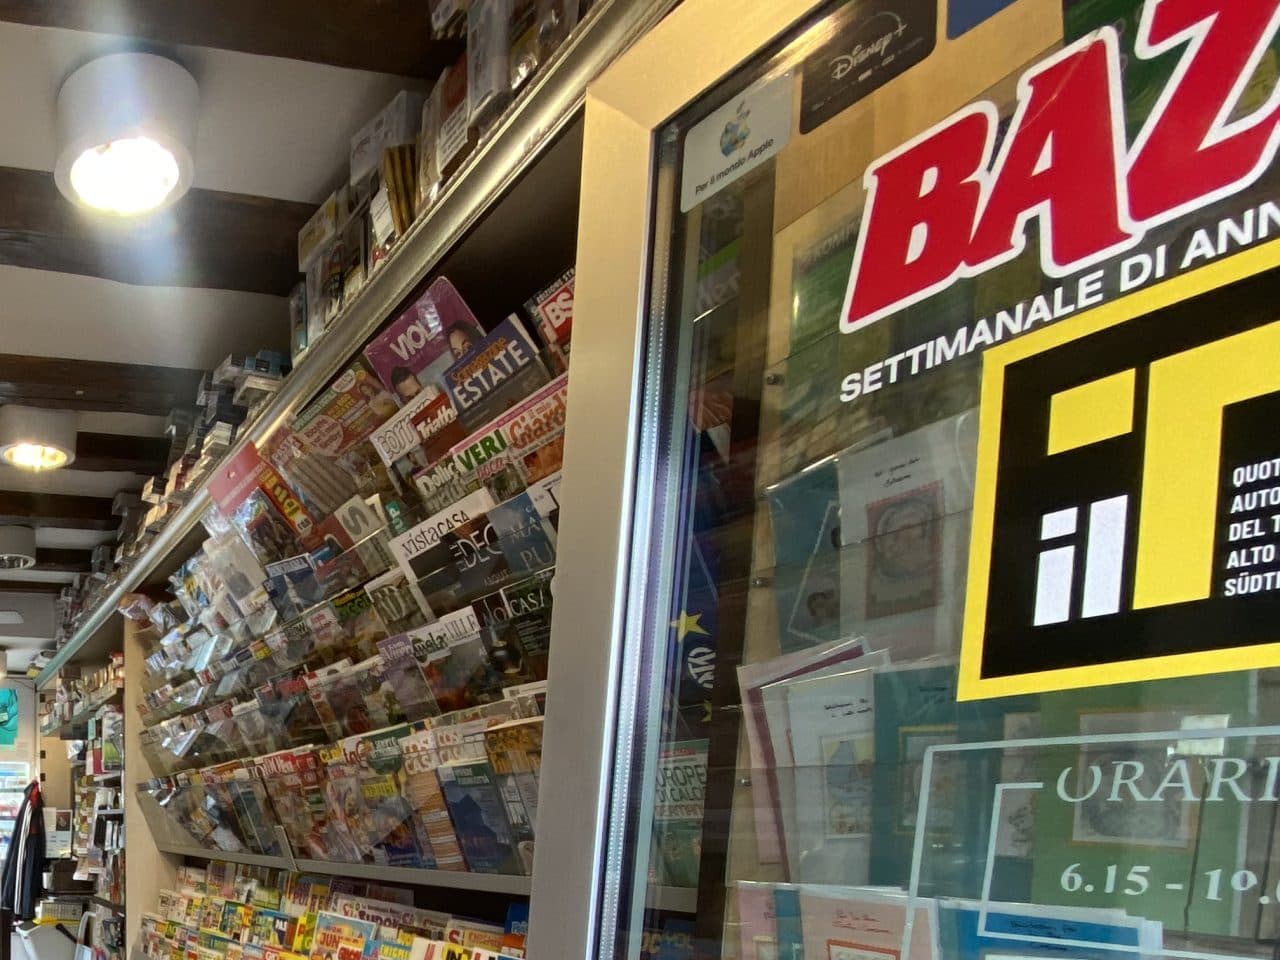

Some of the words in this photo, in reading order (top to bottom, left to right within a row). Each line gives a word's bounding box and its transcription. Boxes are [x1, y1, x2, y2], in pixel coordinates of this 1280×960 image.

[828, 22, 908, 81] Disney+
[695, 181, 709, 195] Per
[716, 158, 745, 181] mondo
[748, 137, 774, 160] Apple
[839, 0, 1280, 334] BAZ
[840, 268, 1105, 402] SETTIMANALE
[1119, 248, 1168, 294] DI
[1180, 202, 1280, 271] ANN
[453, 340, 529, 410] ESTATE
[456, 428, 508, 473] VERI
[1232, 456, 1280, 488] QUOT
[1230, 486, 1280, 514] AUTO
[1228, 518, 1265, 543] DEL
[1226, 544, 1275, 570] ALTO
[1056, 756, 1280, 803] ORARI
[1060, 862, 1151, 896] 6.15
